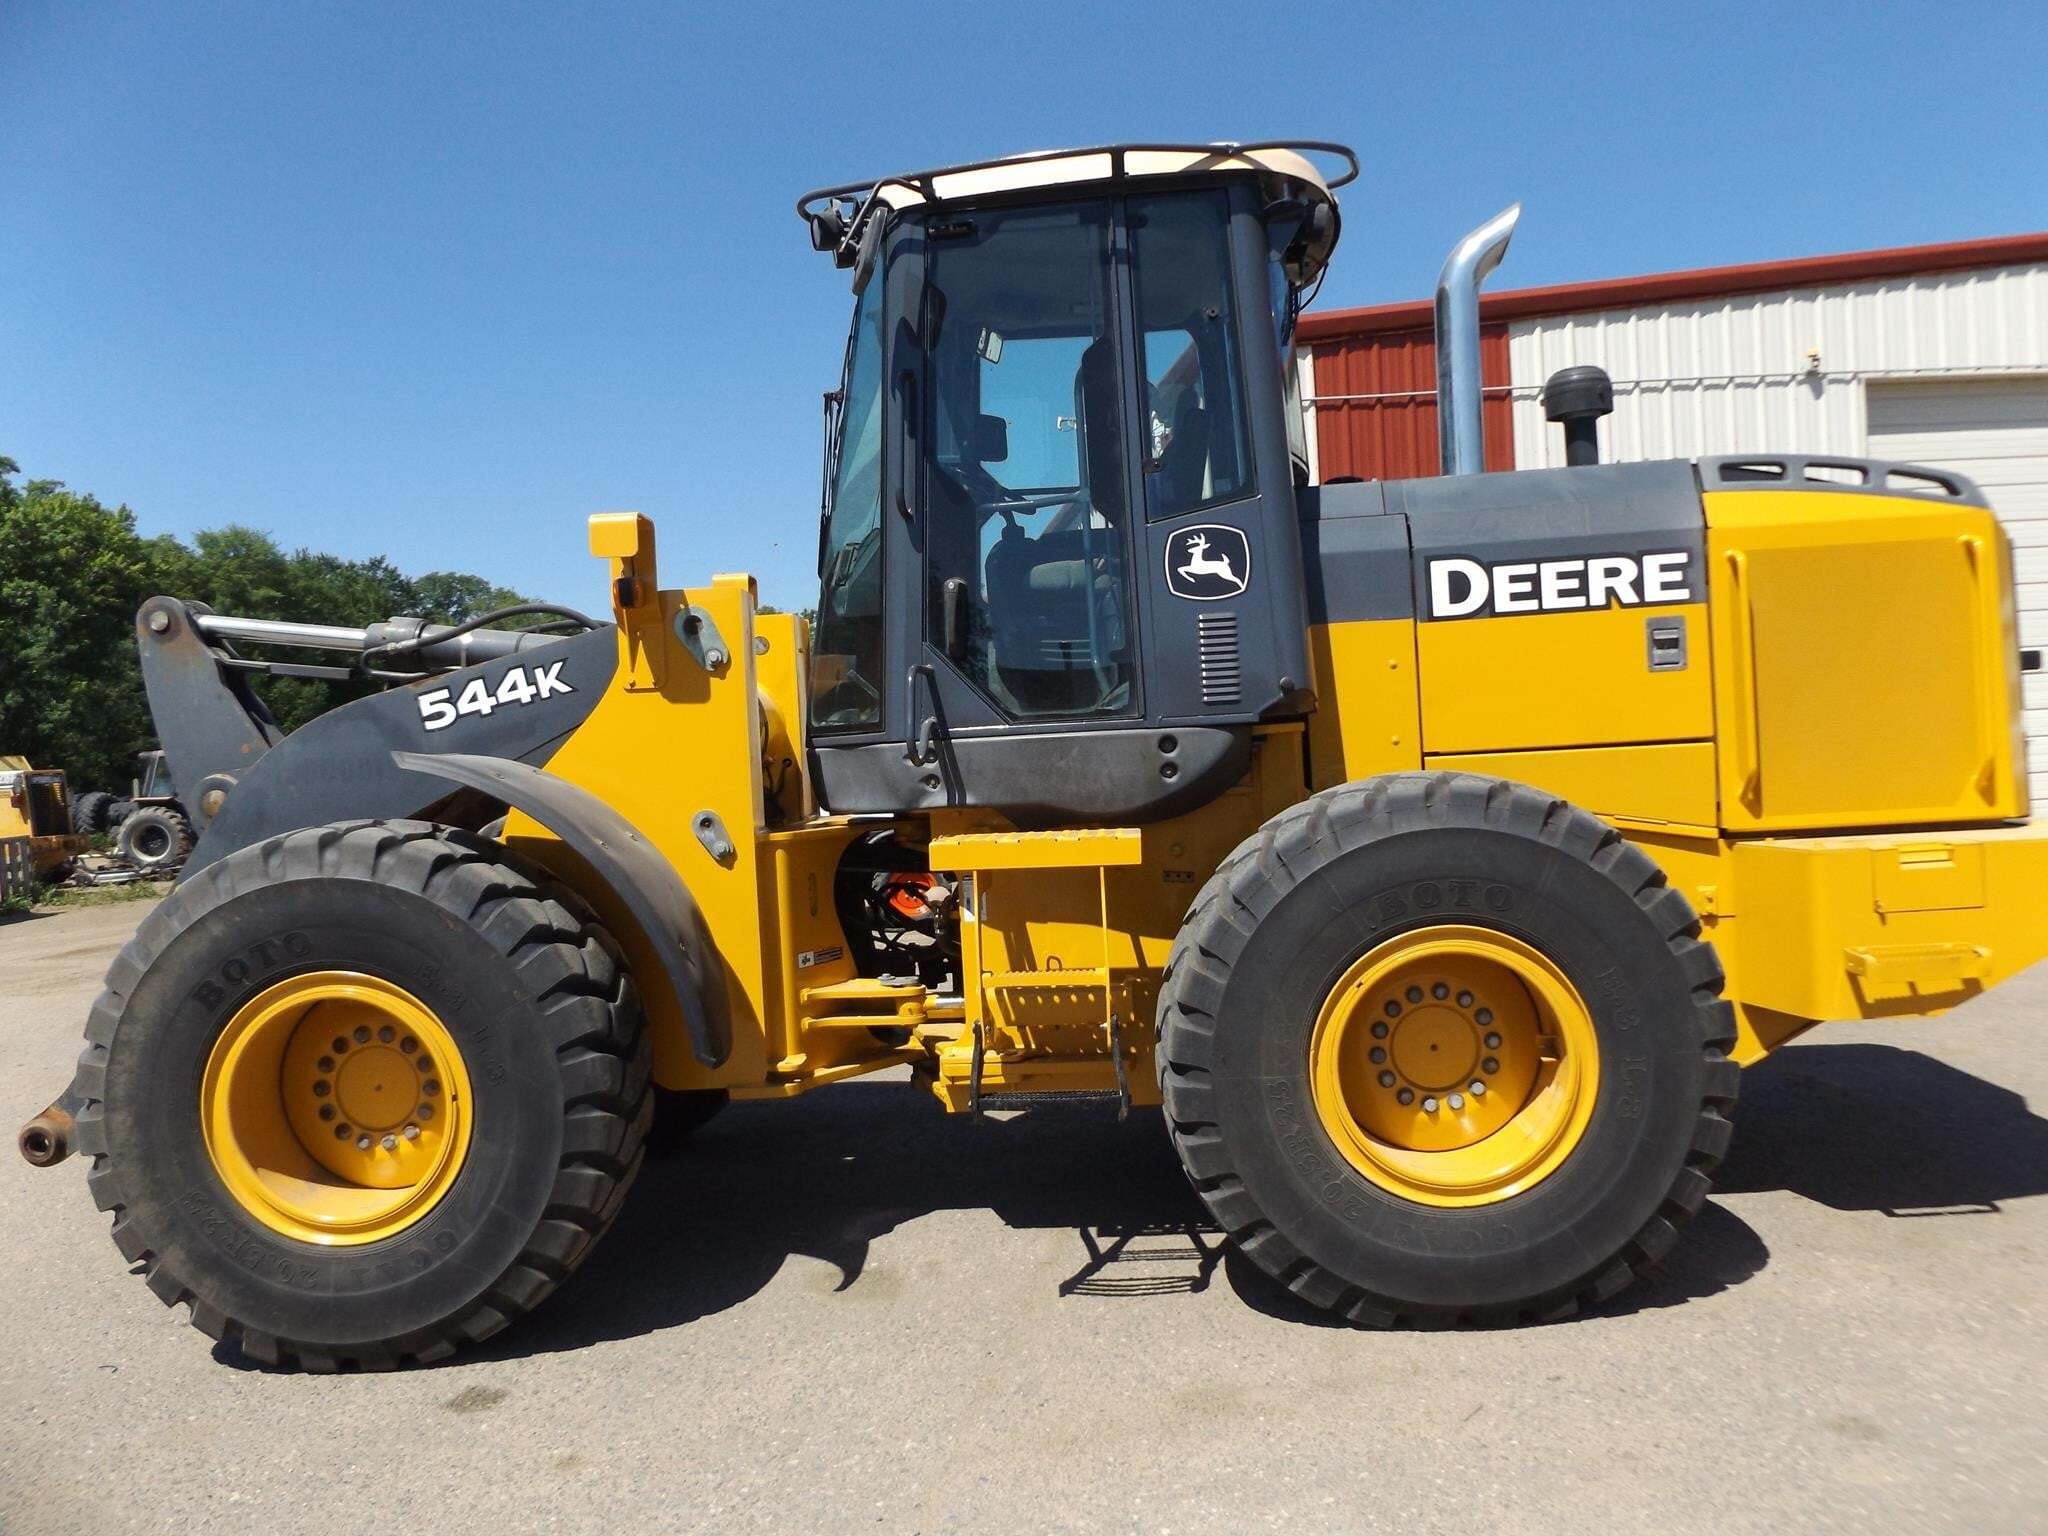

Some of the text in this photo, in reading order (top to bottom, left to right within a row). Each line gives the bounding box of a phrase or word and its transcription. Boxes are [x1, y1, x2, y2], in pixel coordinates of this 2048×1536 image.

[1429, 552, 1691, 618] DEERE
[417, 660, 574, 731] 544K
[1370, 880, 1516, 922] BOTO
[191, 930, 312, 1012] BOTO
